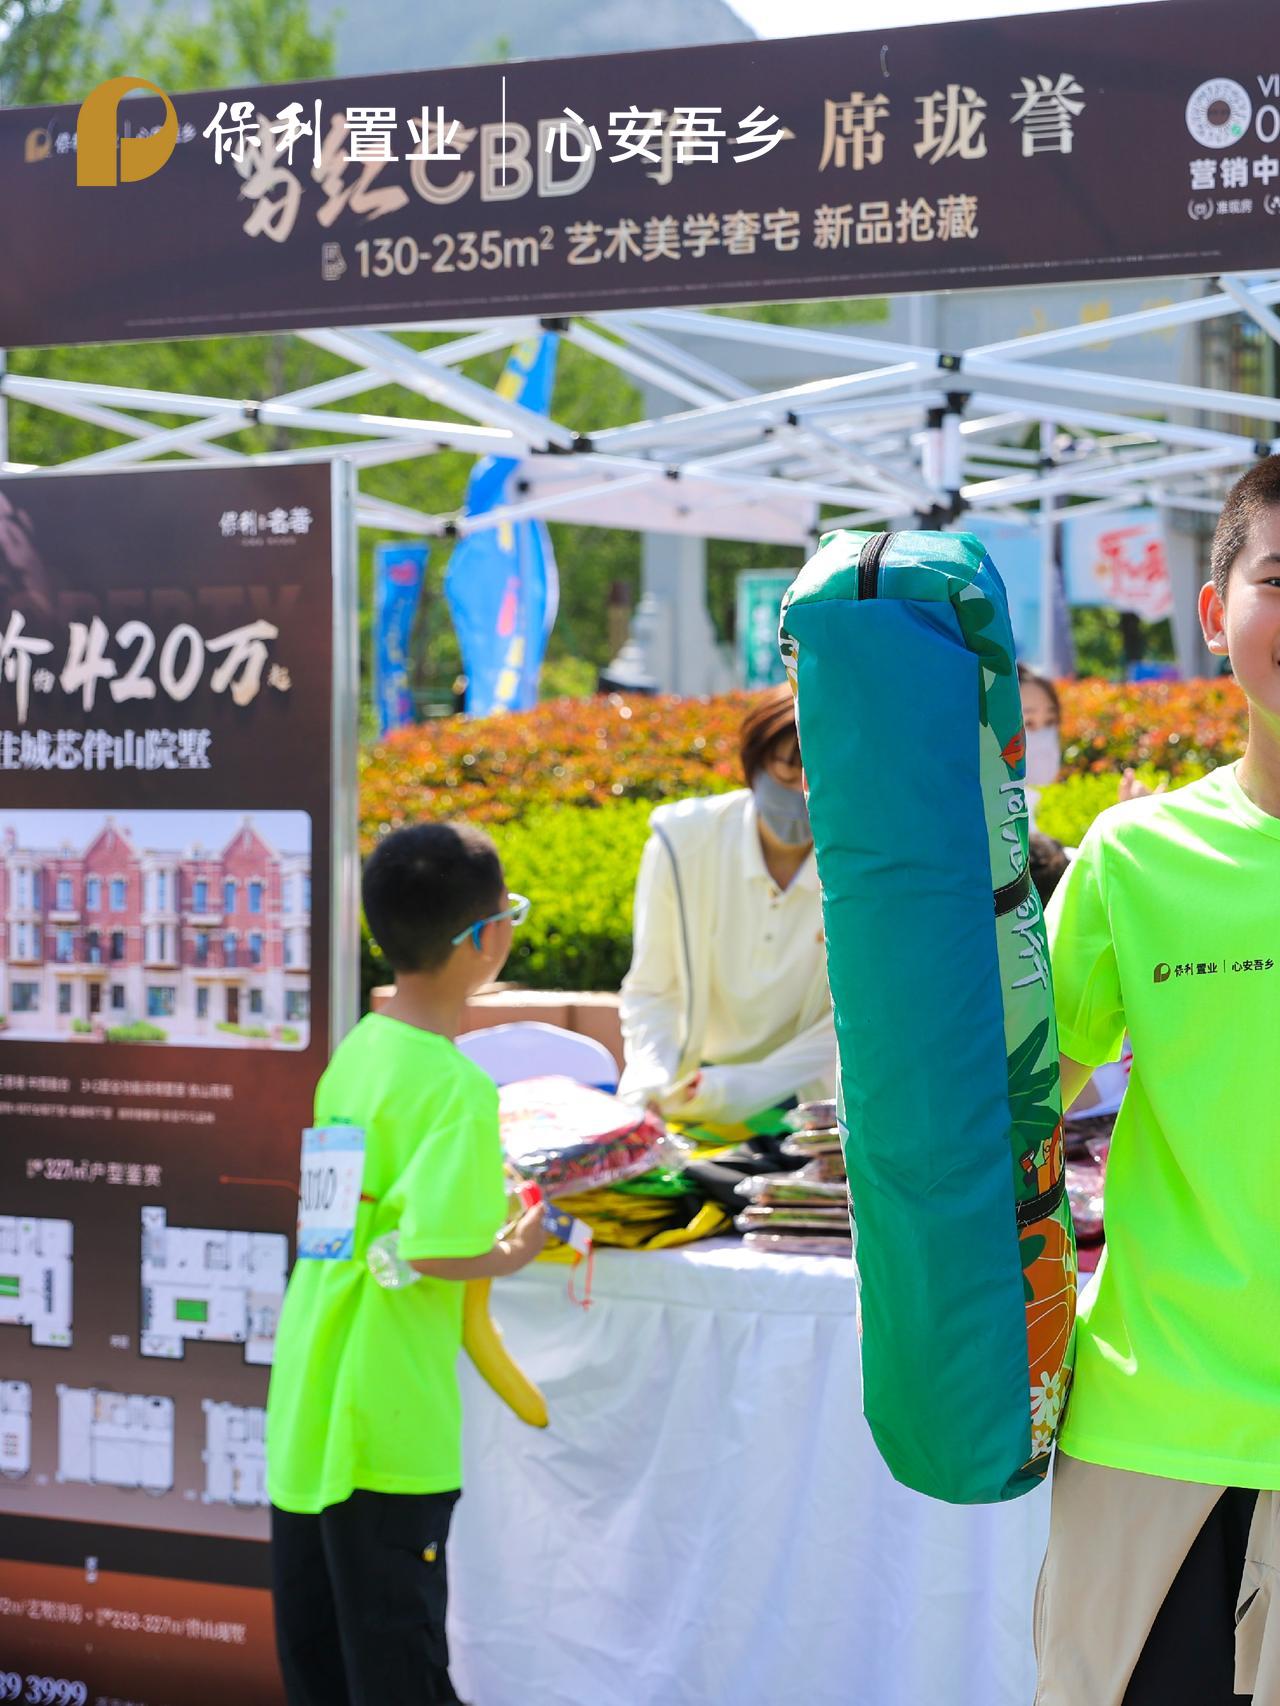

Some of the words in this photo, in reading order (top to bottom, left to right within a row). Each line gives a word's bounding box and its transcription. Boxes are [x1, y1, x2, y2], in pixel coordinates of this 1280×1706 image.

[565, 207, 800, 265] 艺术美学奢宅
[812, 194, 979, 250] 新品抢藏
[1174, 962, 1218, 977] 保利置业
[1231, 959, 1274, 973] 心安吾乡
[25, 1674, 88, 1706] 3999
